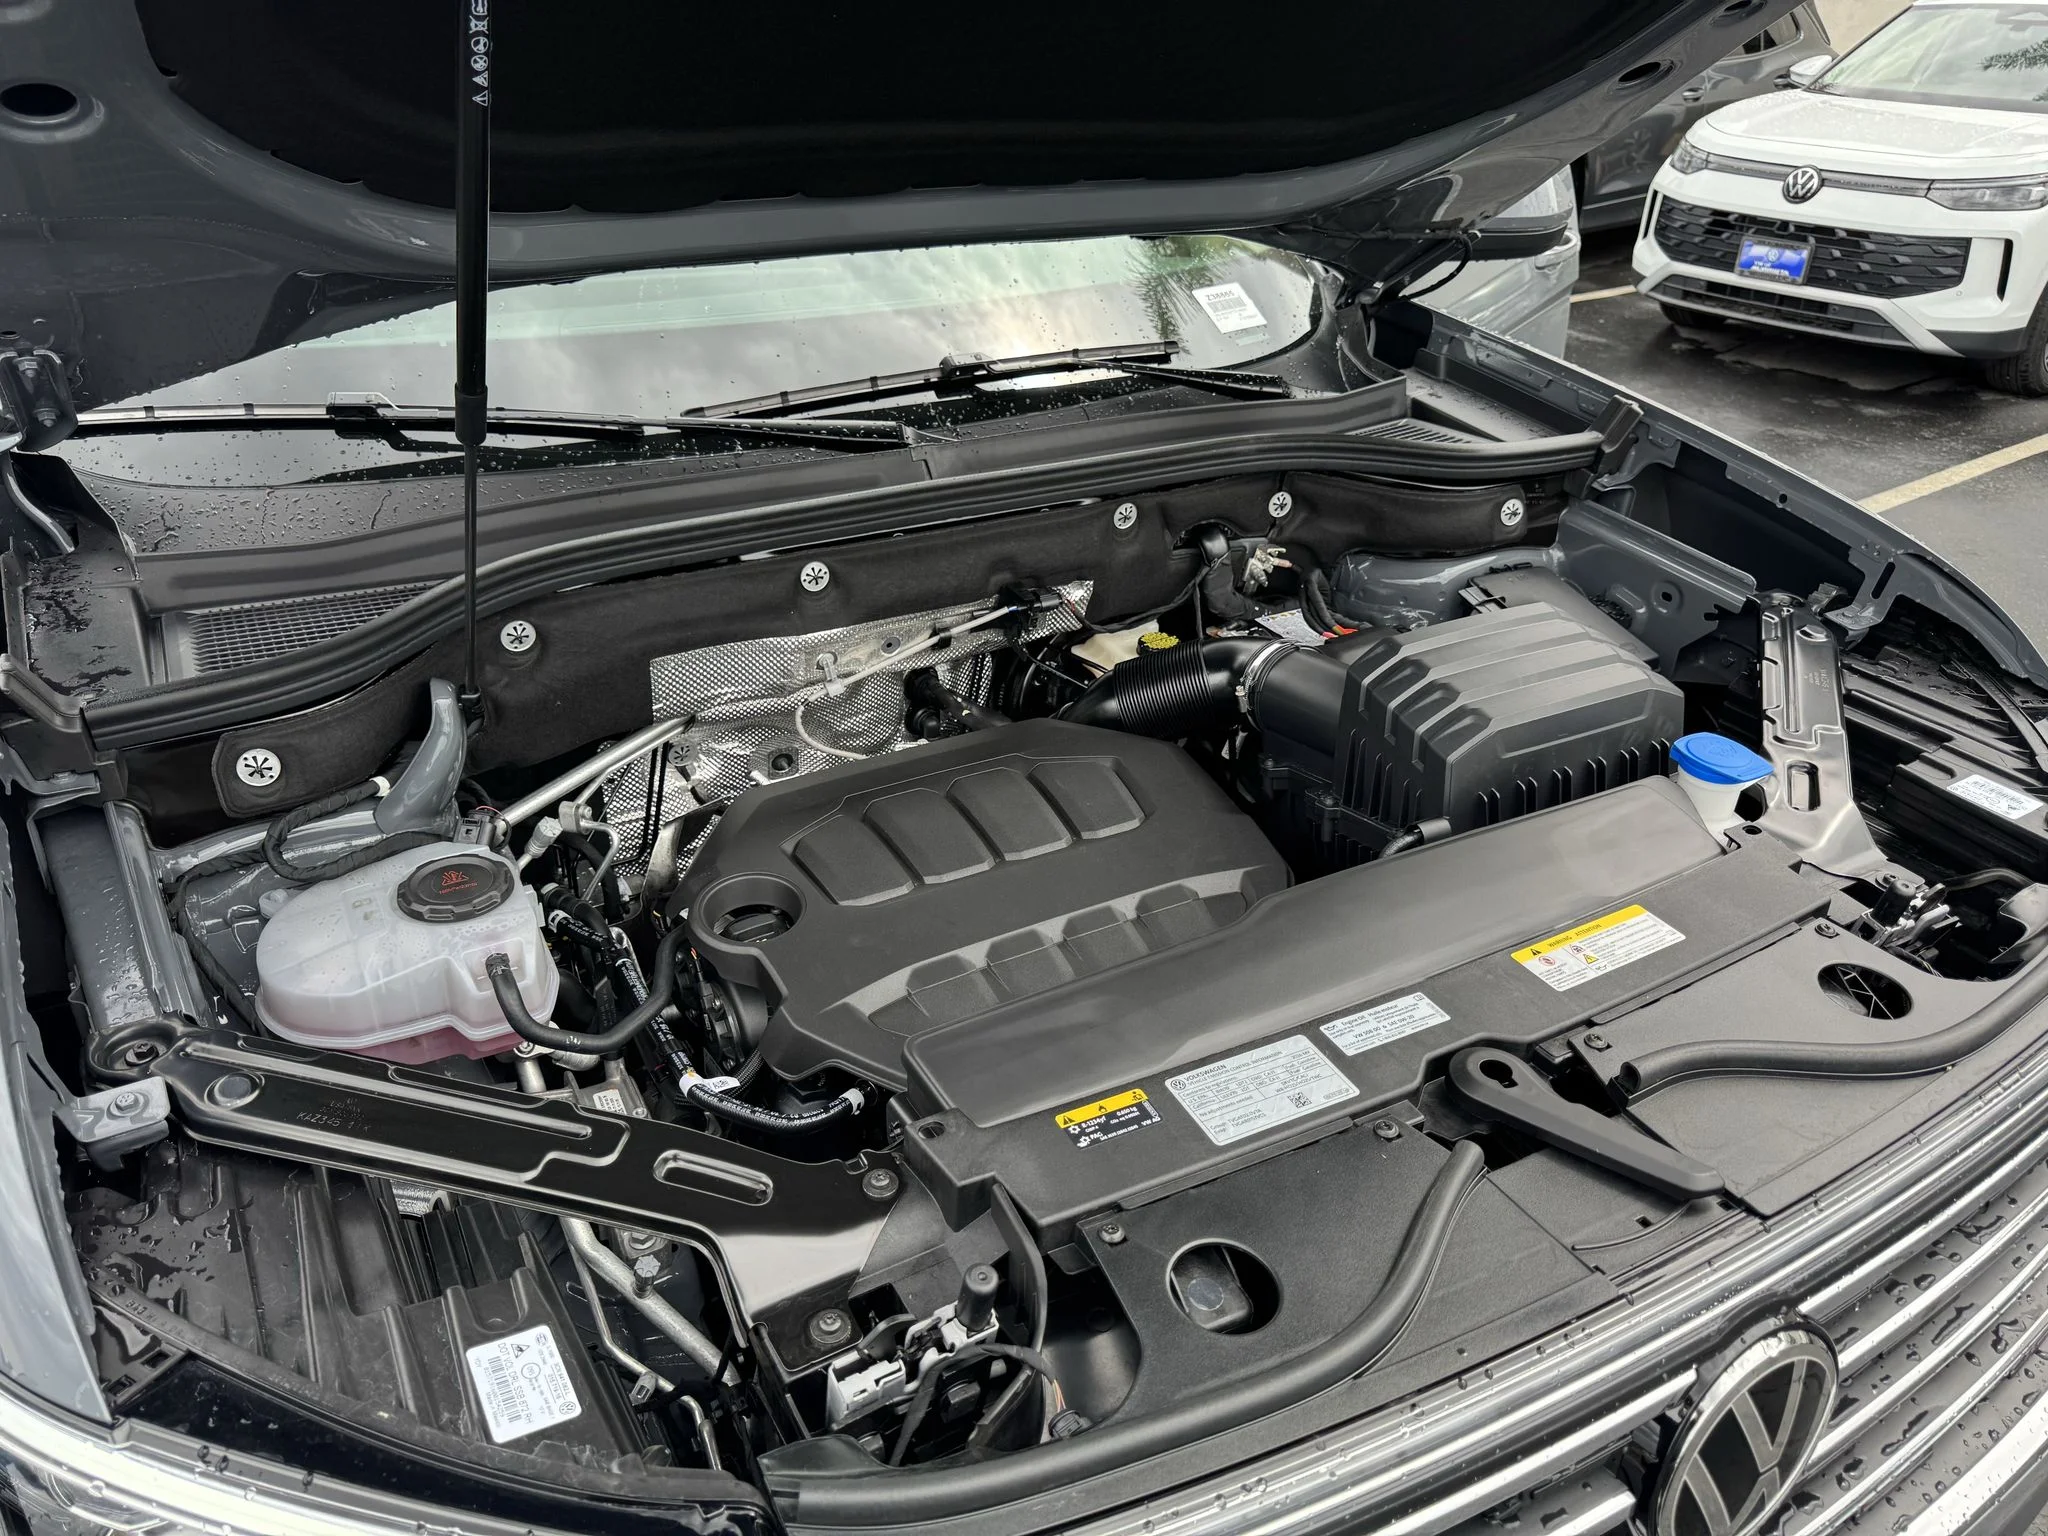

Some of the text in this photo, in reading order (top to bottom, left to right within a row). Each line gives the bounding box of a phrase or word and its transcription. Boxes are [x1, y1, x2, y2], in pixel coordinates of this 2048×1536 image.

[1784, 168, 1818, 200] VW
[1548, 924, 1601, 947] WARNING ATTENTION
[1184, 1064, 1228, 1081] VOLKSWAGEN
[1187, 1051, 1283, 1086] VEHICLE EMISSION CONTROL INFORMATION
[1081, 1116, 1106, 1129] R-1234yf
[1141, 1118, 1152, 1126] VW
[1090, 1131, 1103, 1139] PAG
[497, 1341, 509, 1356] DOT
[502, 1356, 515, 1371] VOL
[507, 1370, 520, 1385] DRL
[522, 1412, 534, 1424] RH
